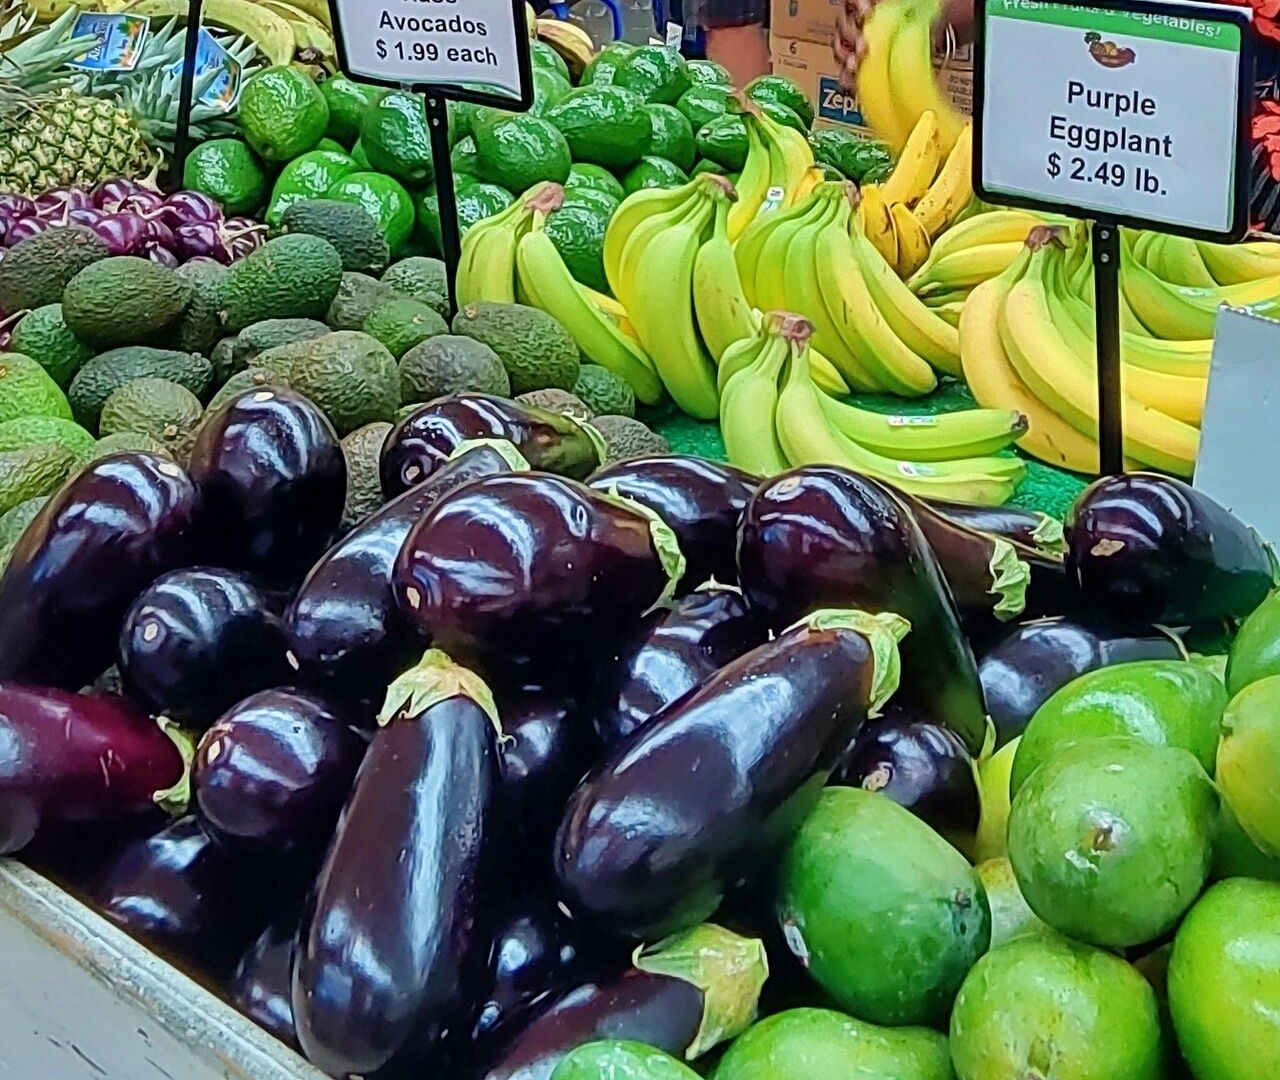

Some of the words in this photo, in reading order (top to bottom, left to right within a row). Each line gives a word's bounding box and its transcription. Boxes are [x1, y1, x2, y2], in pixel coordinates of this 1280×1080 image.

[379, 10, 488, 37] Avocados
[376, 38, 388, 60] $
[394, 41, 439, 62] 1.99
[447, 46, 499, 67] each
[1067, 80, 1157, 118] Purple
[1050, 115, 1173, 158] Eggplant
[1046, 151, 1062, 180] $
[1070, 157, 1126, 187] 2.49
[1135, 167, 1168, 196] lb.
